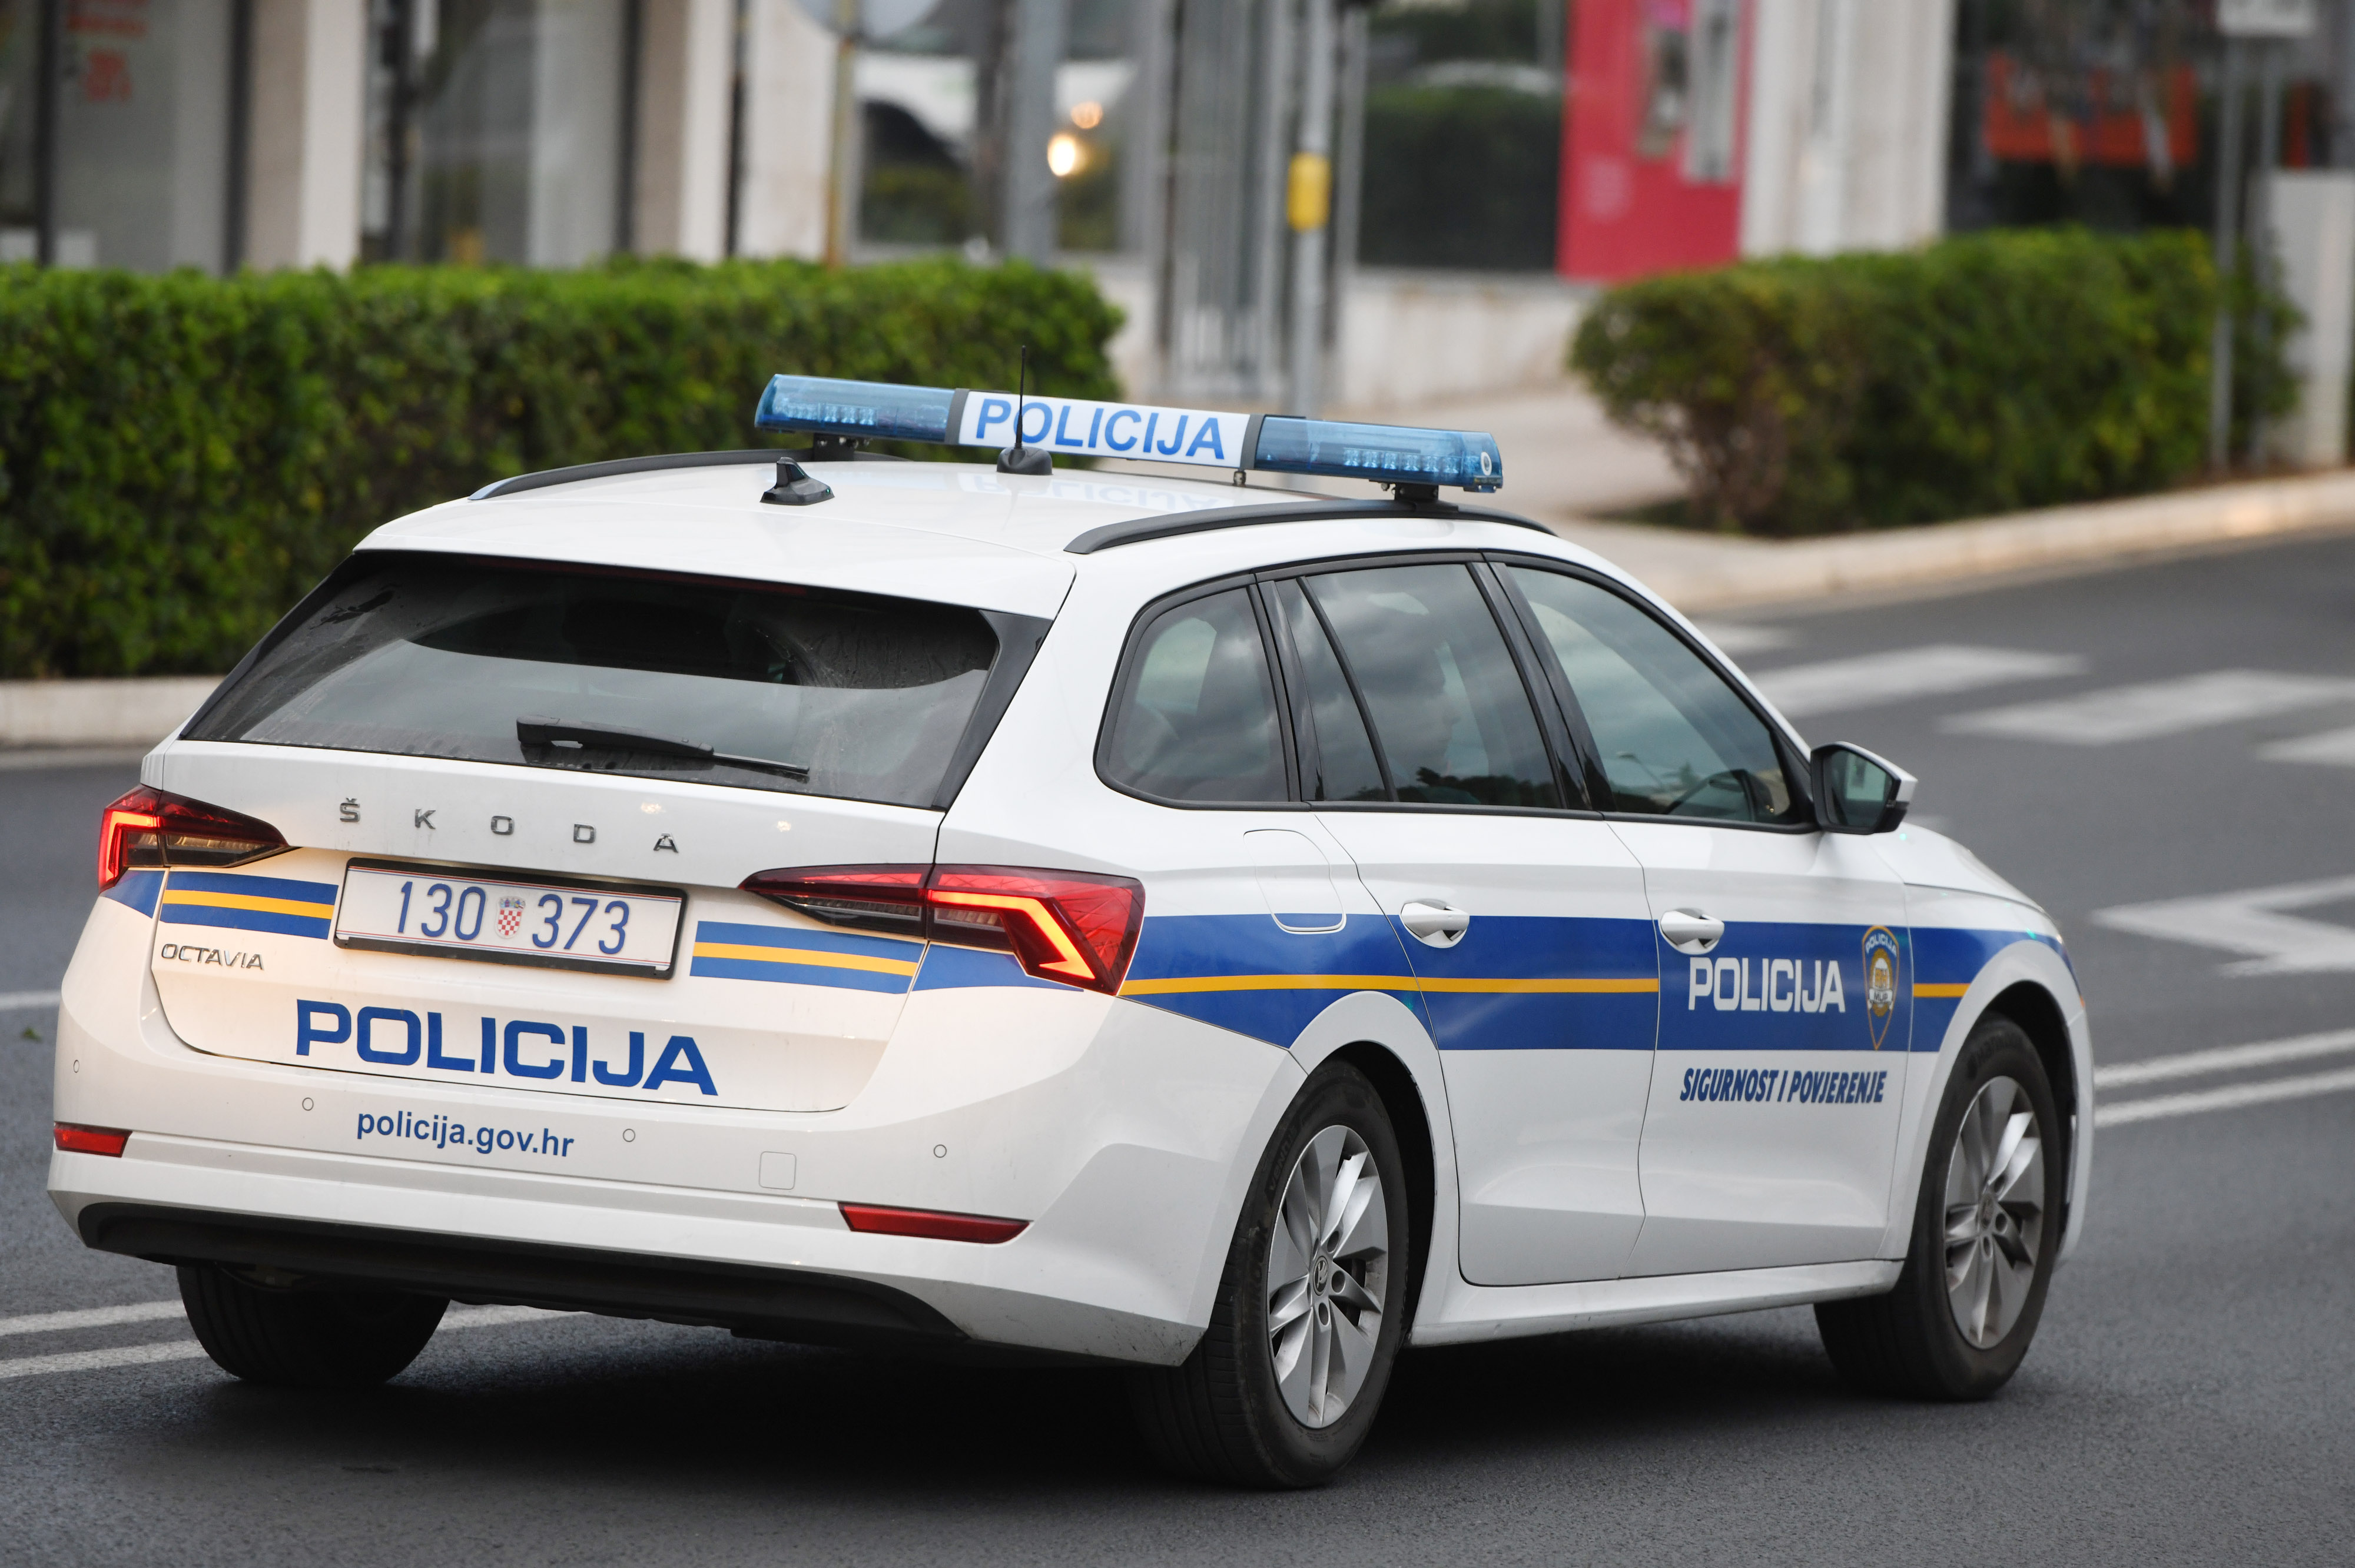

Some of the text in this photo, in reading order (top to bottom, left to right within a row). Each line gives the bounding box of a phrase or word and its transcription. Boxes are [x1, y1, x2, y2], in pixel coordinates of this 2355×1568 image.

[976, 398, 1225, 460] POLICIJA
[339, 797, 679, 853] ŠKODA
[399, 881, 630, 955] 130 373
[1865, 934, 1897, 957] POLICIJA
[161, 944, 264, 971] OCTAVIA
[1689, 957, 1846, 1013] POLICIJA
[296, 999, 718, 1096] POLICIJA
[1680, 1068, 1888, 1104] SIGURNOST I POVJERENJE
[357, 1111, 575, 1157] policija.gov.hr
